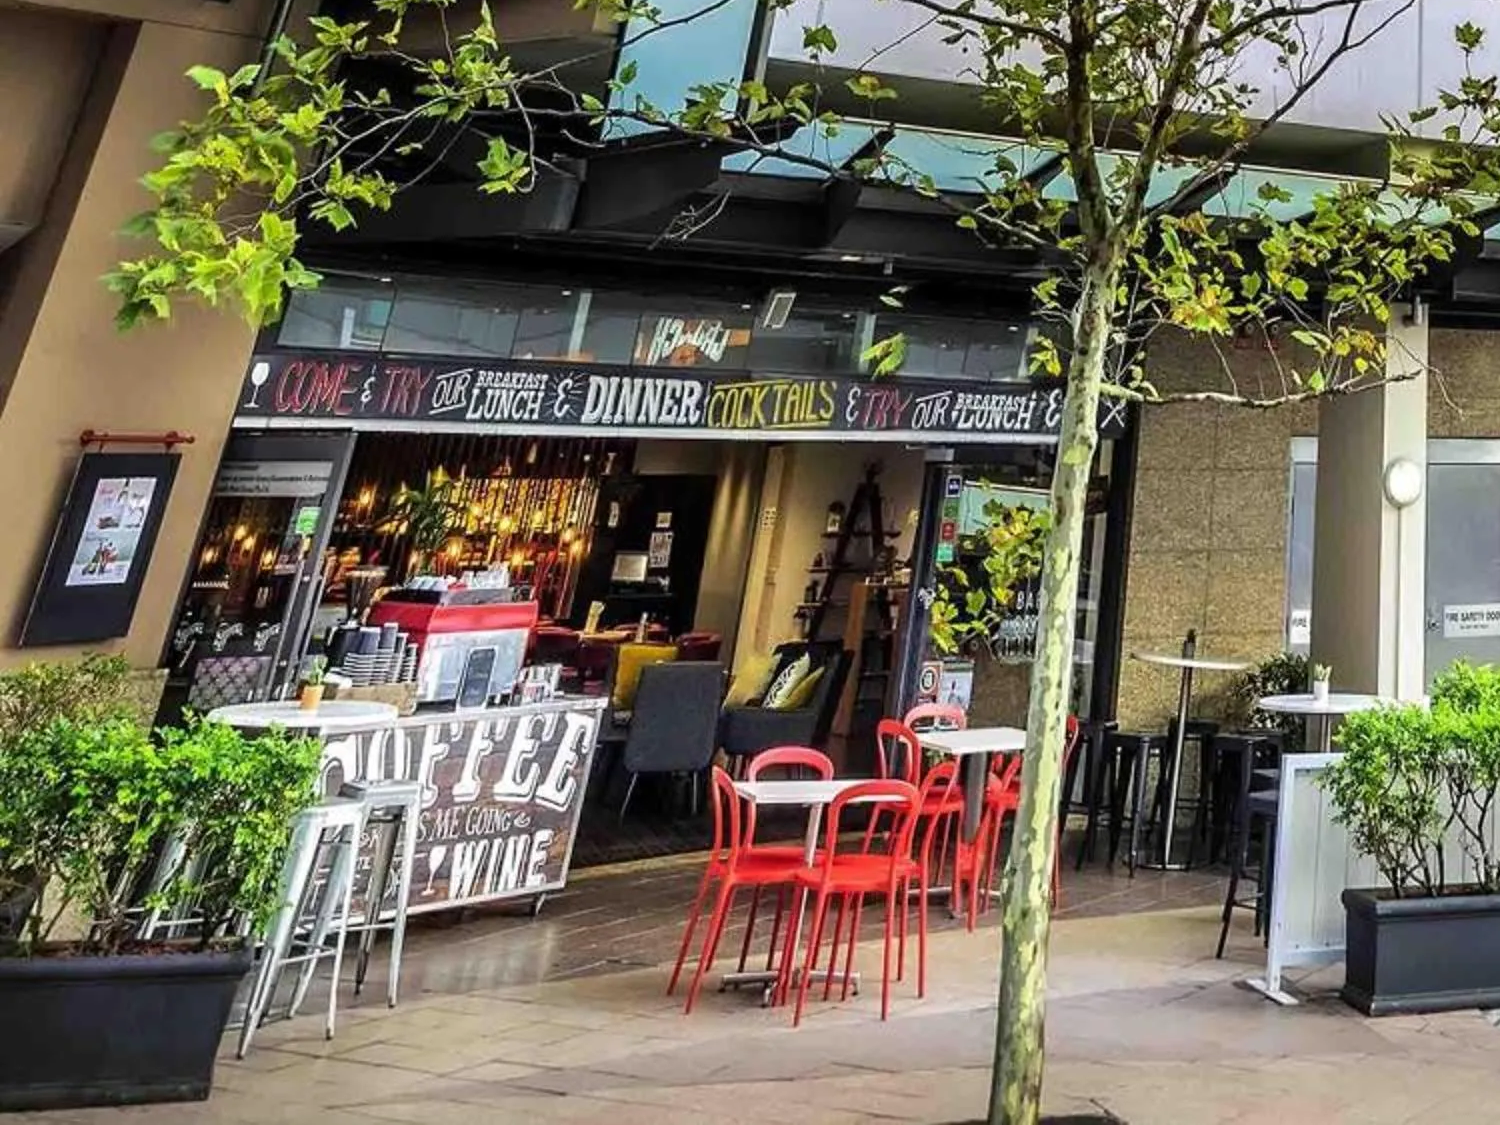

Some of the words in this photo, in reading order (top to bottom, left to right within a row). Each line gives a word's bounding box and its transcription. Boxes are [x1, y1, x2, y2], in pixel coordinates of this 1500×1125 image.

[274, 359, 361, 415] COME
[380, 365, 434, 416] TRY
[432, 371, 472, 409] OUR
[476, 370, 548, 390] BREAKFAST
[466, 387, 545, 421] LUNCH
[552, 376, 574, 419] &
[581, 374, 702, 425] DINNER
[863, 384, 912, 432] TRY
[911, 395, 951, 431] OUR
[954, 392, 1030, 413] BREAKFAST
[956, 397, 1037, 431] LUNCH
[1460, 611, 1484, 622] SAFETY
[427, 807, 464, 842] ME
[465, 805, 512, 836] GOING
[449, 828, 556, 900] WINE
